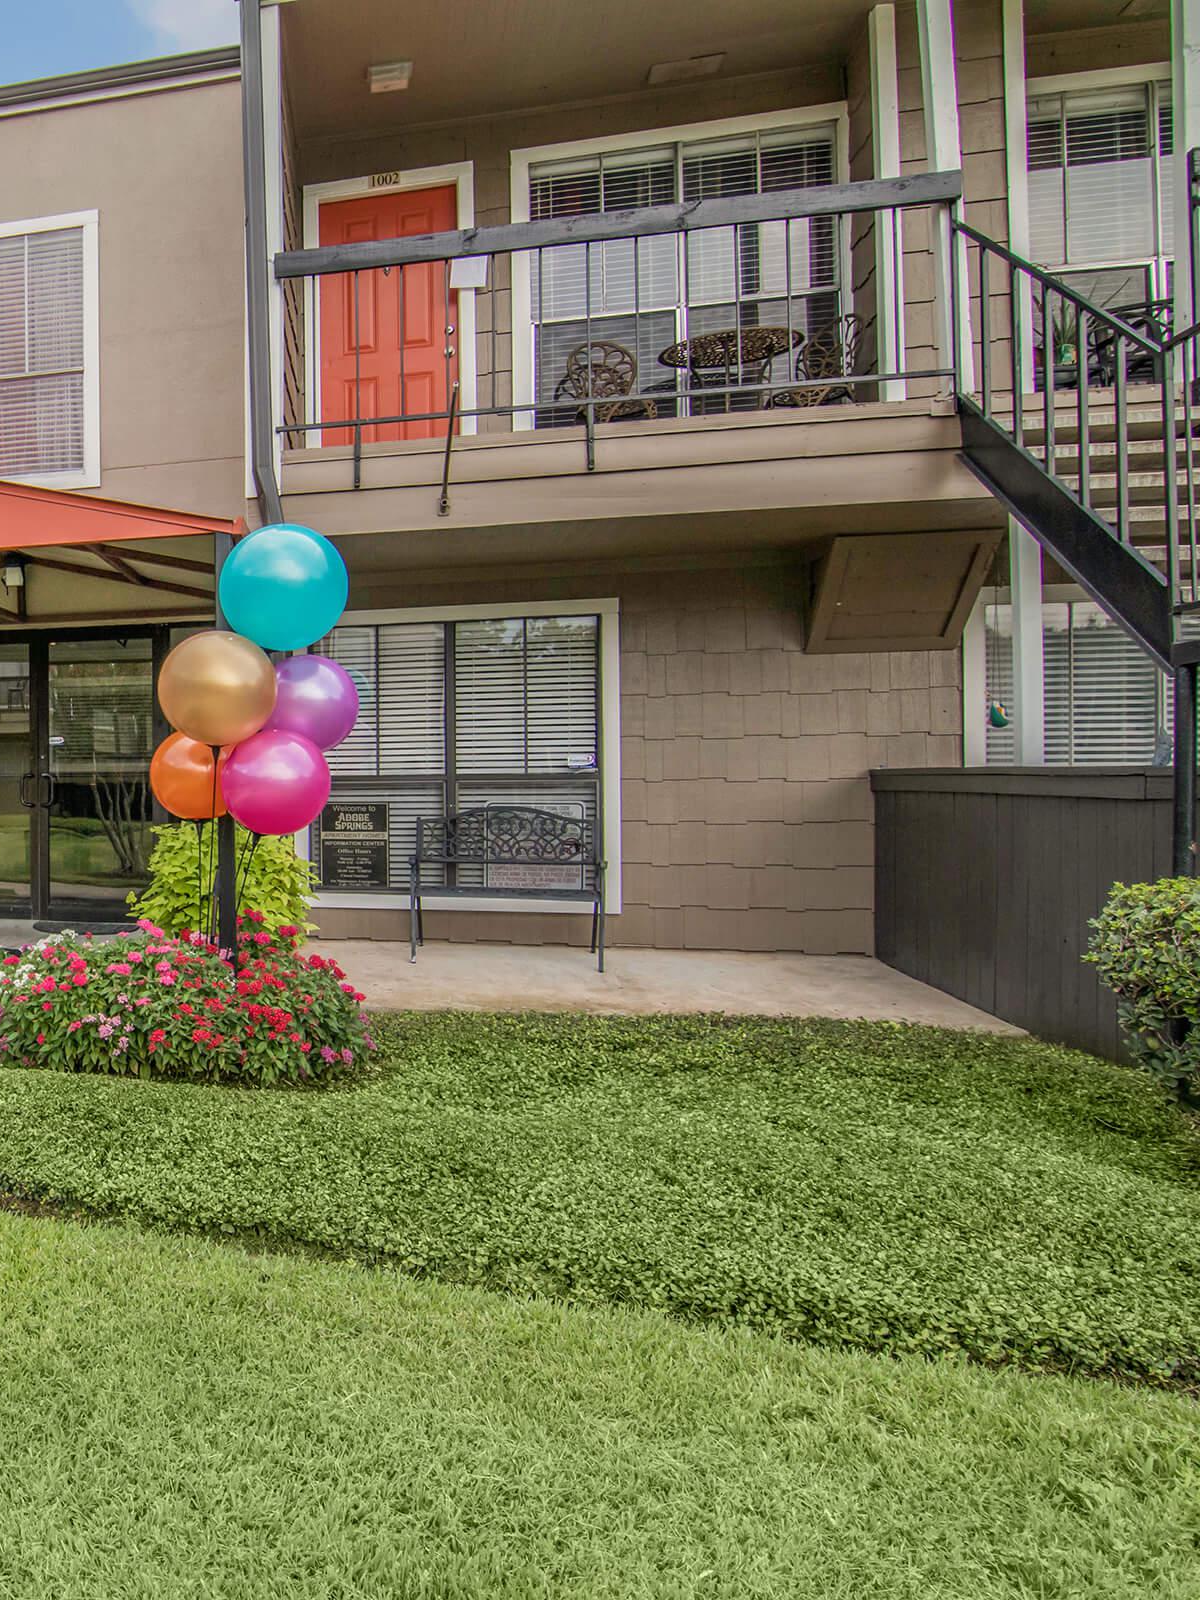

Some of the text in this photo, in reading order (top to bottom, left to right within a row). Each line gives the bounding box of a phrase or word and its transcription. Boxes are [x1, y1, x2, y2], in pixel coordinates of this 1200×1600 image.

[372, 172, 399, 187] 1002
[338, 812, 370, 822] ADOBE
[335, 822, 374, 831] SPRINGS
